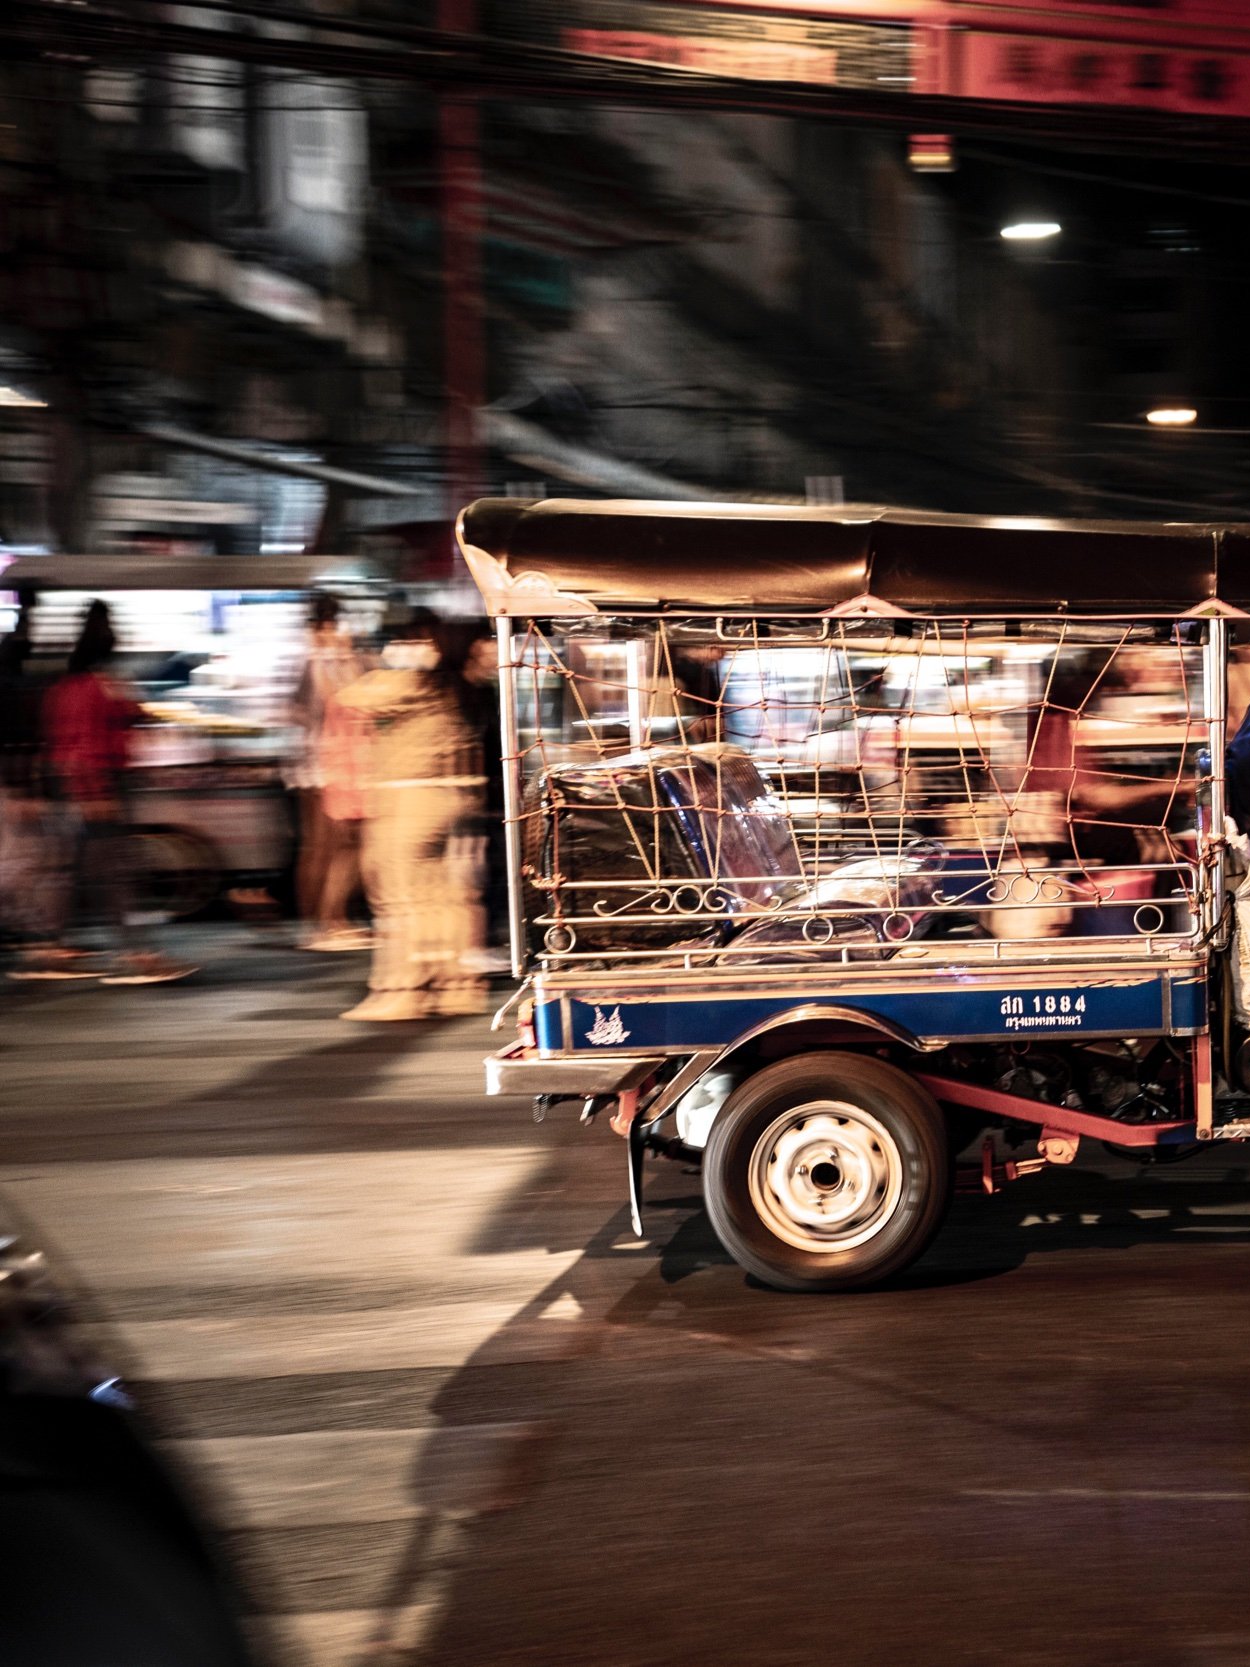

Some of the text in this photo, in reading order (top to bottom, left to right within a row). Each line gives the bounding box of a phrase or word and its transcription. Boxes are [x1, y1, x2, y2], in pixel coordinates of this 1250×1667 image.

[1033, 995, 1086, 1013] 1884
[1005, 1015, 1081, 1030] กรุงเทพมหานคร
